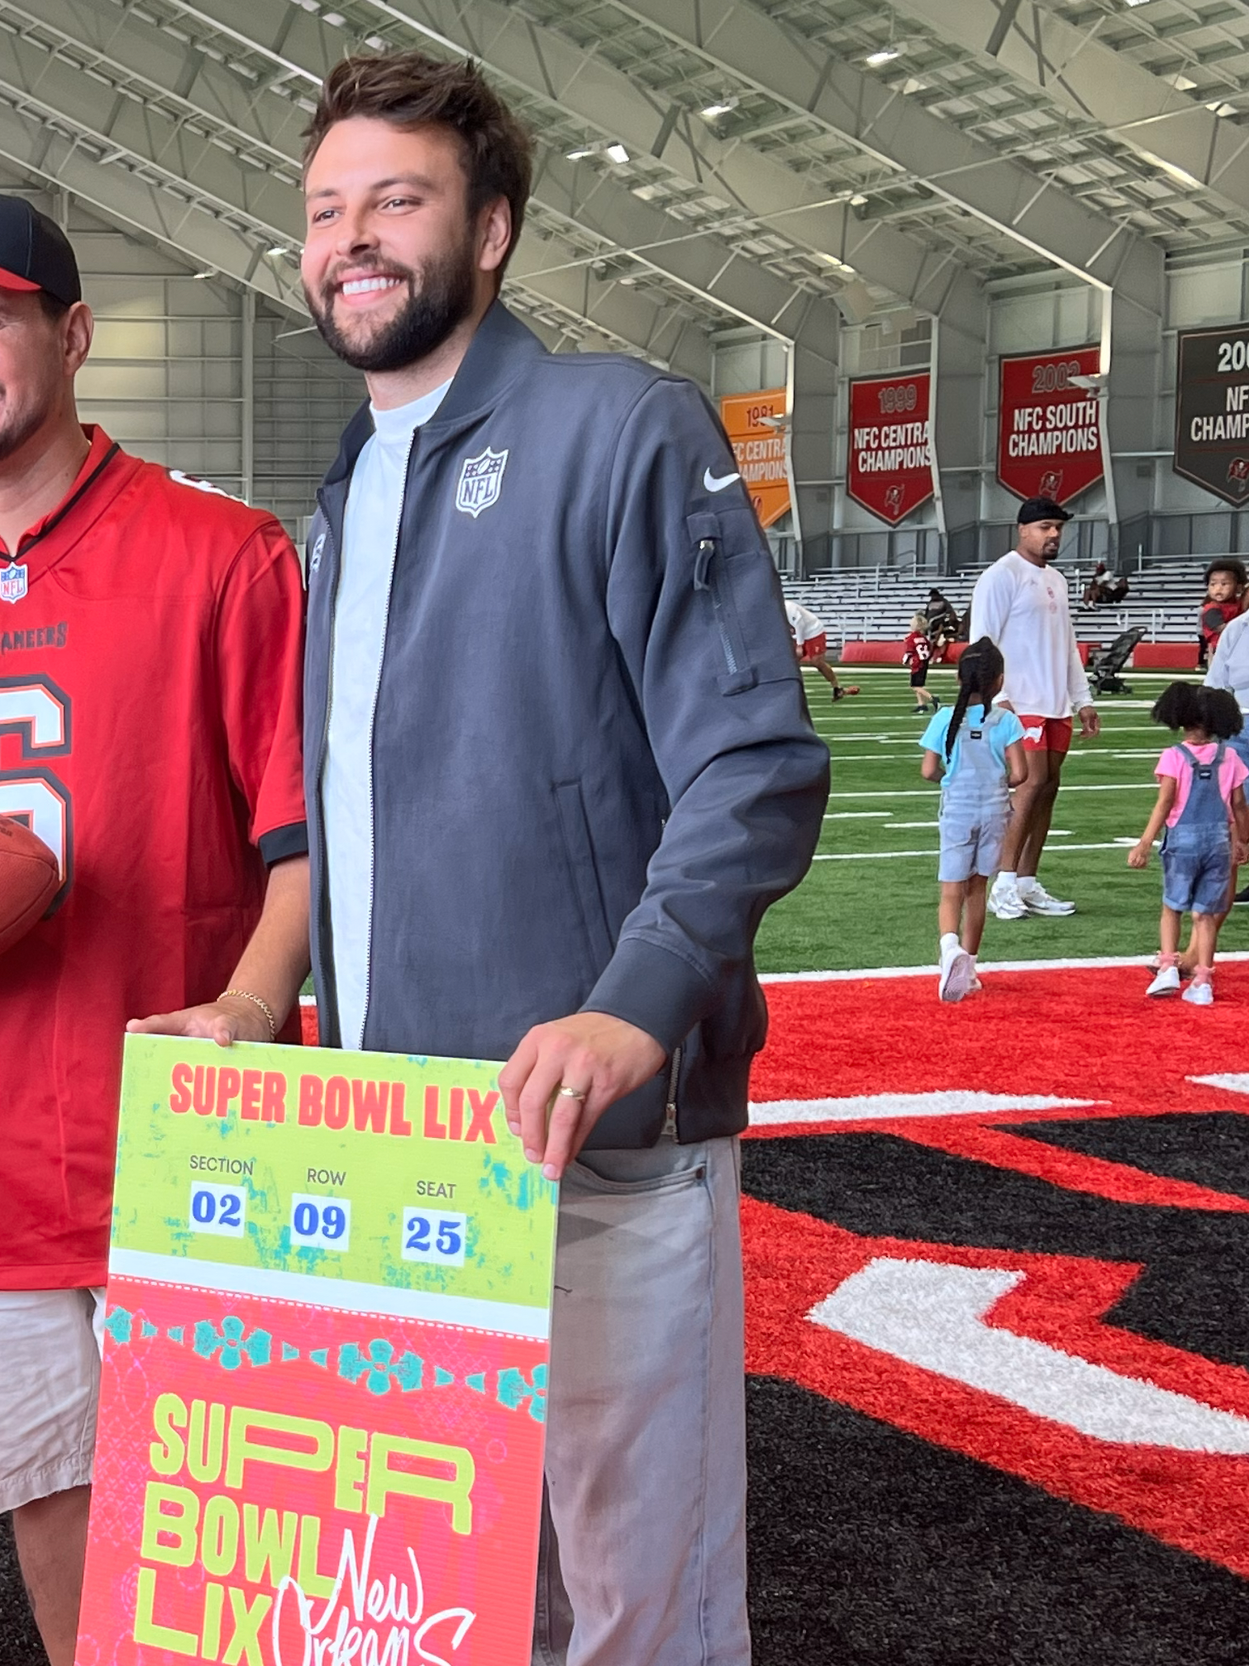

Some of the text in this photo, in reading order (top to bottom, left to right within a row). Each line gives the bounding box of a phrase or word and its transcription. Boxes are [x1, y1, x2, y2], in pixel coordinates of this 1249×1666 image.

[1217, 340, 1249, 372] 20
[878, 384, 917, 414] 1999
[1014, 400, 1097, 432] NFC SOUTH
[853, 426, 879, 449] NFC
[1008, 426, 1098, 457] CHAMPIONS
[858, 445, 932, 473] CHAMPIONS
[462, 475, 494, 505] NFL
[2, 580, 23, 596] NFL
[169, 1061, 501, 1145] SUPER BOWL LIX
[189, 1154, 254, 1176] SECTION
[306, 1167, 347, 1187] ROW
[416, 1180, 457, 1200] SEAT
[191, 1190, 242, 1228] 02
[293, 1201, 346, 1240] 09
[405, 1216, 462, 1256] 25
[149, 1392, 476, 1535] SUPER
[140, 1481, 342, 1600] BOWL
[322, 1513, 424, 1625] New
[133, 1567, 274, 1666] LIX
